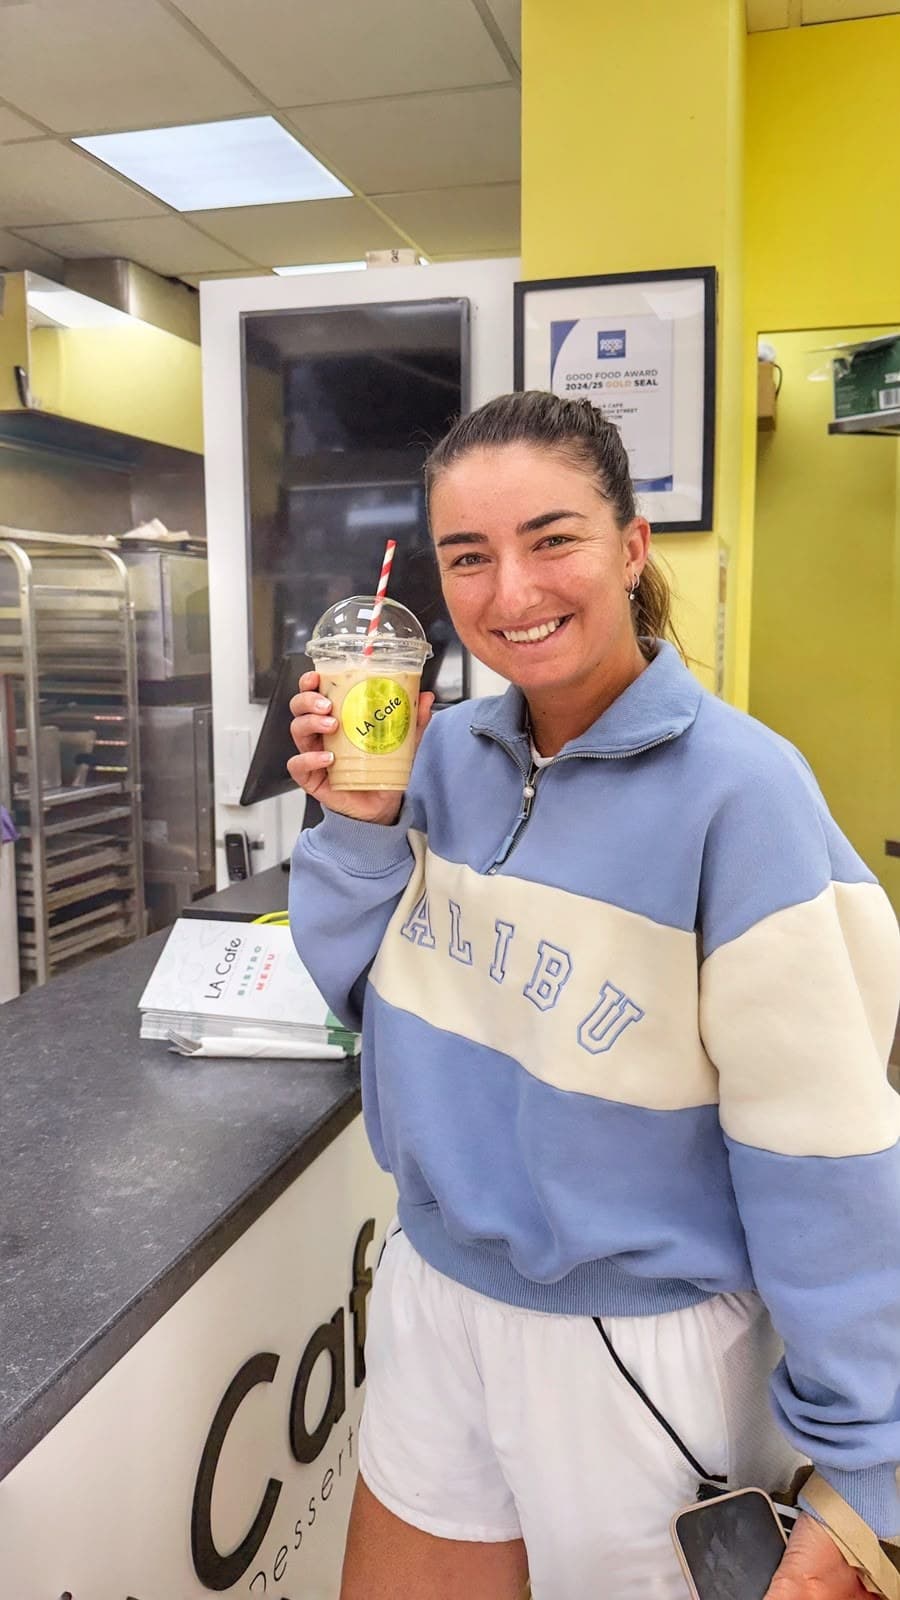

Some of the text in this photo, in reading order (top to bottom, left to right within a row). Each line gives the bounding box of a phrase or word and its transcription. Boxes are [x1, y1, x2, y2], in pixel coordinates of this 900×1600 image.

[565, 381, 603, 390] 2024/25
[606, 380, 632, 388] GOLD
[566, 369, 658, 381] GOOD FOOD AWARD
[356, 720, 375, 737] LA
[374, 697, 401, 721] Cafe
[204, 937, 242, 999] LA Cafe
[237, 946, 262, 996] BISTRO
[255, 953, 275, 991] MENU
[400, 887, 645, 1055] ALIBU
[191, 1218, 376, 1591] Caf
[249, 1415, 362, 1592] essert
